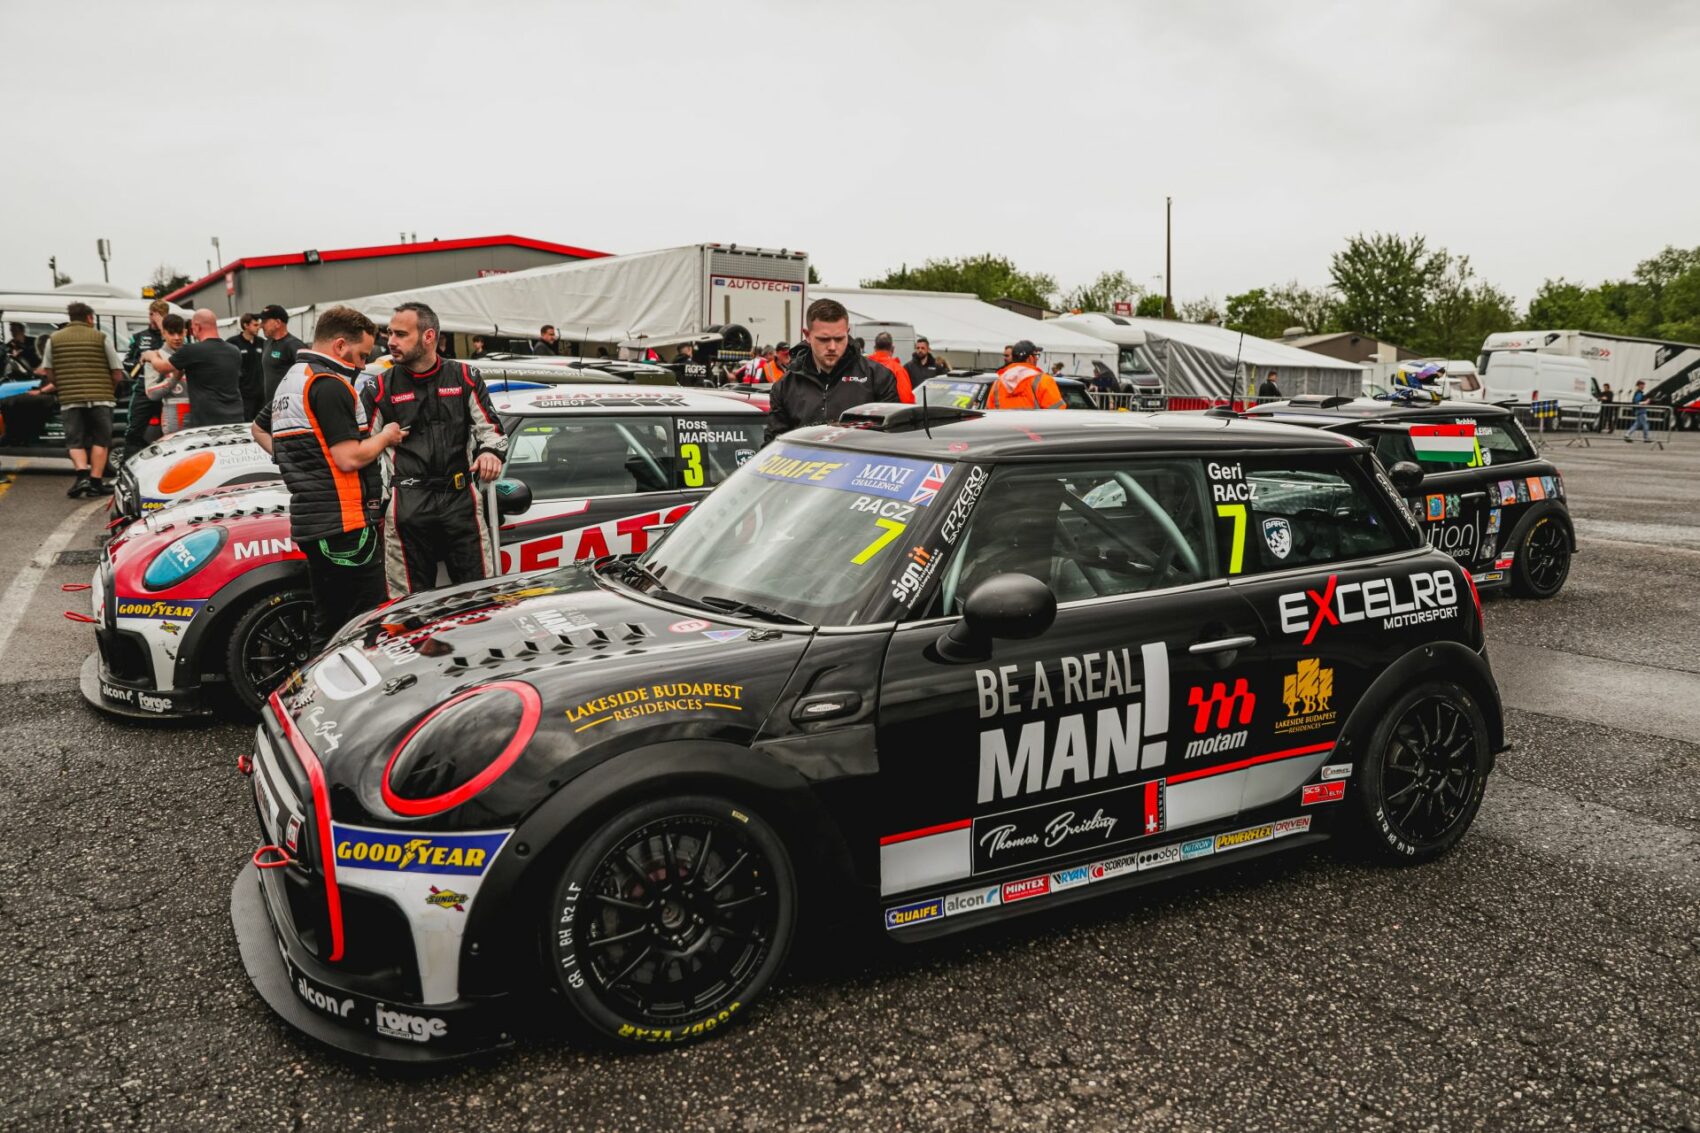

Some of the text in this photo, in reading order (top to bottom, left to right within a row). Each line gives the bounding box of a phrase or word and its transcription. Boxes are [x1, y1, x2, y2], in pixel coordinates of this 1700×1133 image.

[727, 279, 790, 292] AUTOTECH
[541, 399, 586, 407] DIRECT
[677, 419, 707, 431] Ross
[679, 431, 748, 444] MARSHALL
[680, 444, 704, 488] 3
[756, 454, 844, 481] QUAIFE
[856, 464, 915, 484] MINI
[1208, 462, 1242, 480] Geri
[851, 478, 903, 493] CHALLENGE
[1213, 483, 1259, 502] RACZ
[850, 496, 917, 522] RACZ
[1265, 521, 1287, 529] BARC
[233, 537, 300, 560] MIN
[850, 518, 907, 565] 7
[1216, 504, 1247, 574] 7
[168, 541, 196, 568] SPEC
[119, 601, 194, 617] GOODYEAR
[1384, 606, 1459, 630] MOTORSPORT
[975, 648, 1142, 719] BE A REAL
[565, 683, 743, 722] LAKESIDE BUDAPEST
[613, 699, 703, 721] RESIDENCES
[977, 641, 1170, 804] MAN!
[1305, 711, 1337, 724] BUDAPEST
[1185, 730, 1249, 760] motam
[1304, 786, 1320, 795] SCS
[980, 808, 1118, 858] Thomas Breitling
[1275, 816, 1311, 832] DRIVEN
[1184, 841, 1211, 853] NITRON
[1216, 826, 1274, 849] POWERFLEX
[336, 839, 486, 869] GOODYEAR
[1104, 854, 1136, 872] SCORPION
[566, 882, 582, 901] LF
[1005, 877, 1045, 895] MINTEX
[427, 894, 469, 905] SUNOCO
[947, 894, 985, 911] alcon
[894, 904, 938, 923] QUAIFE
[567, 969, 585, 989] GR
[298, 978, 338, 1015] alcon
[376, 1003, 448, 1042] forge
